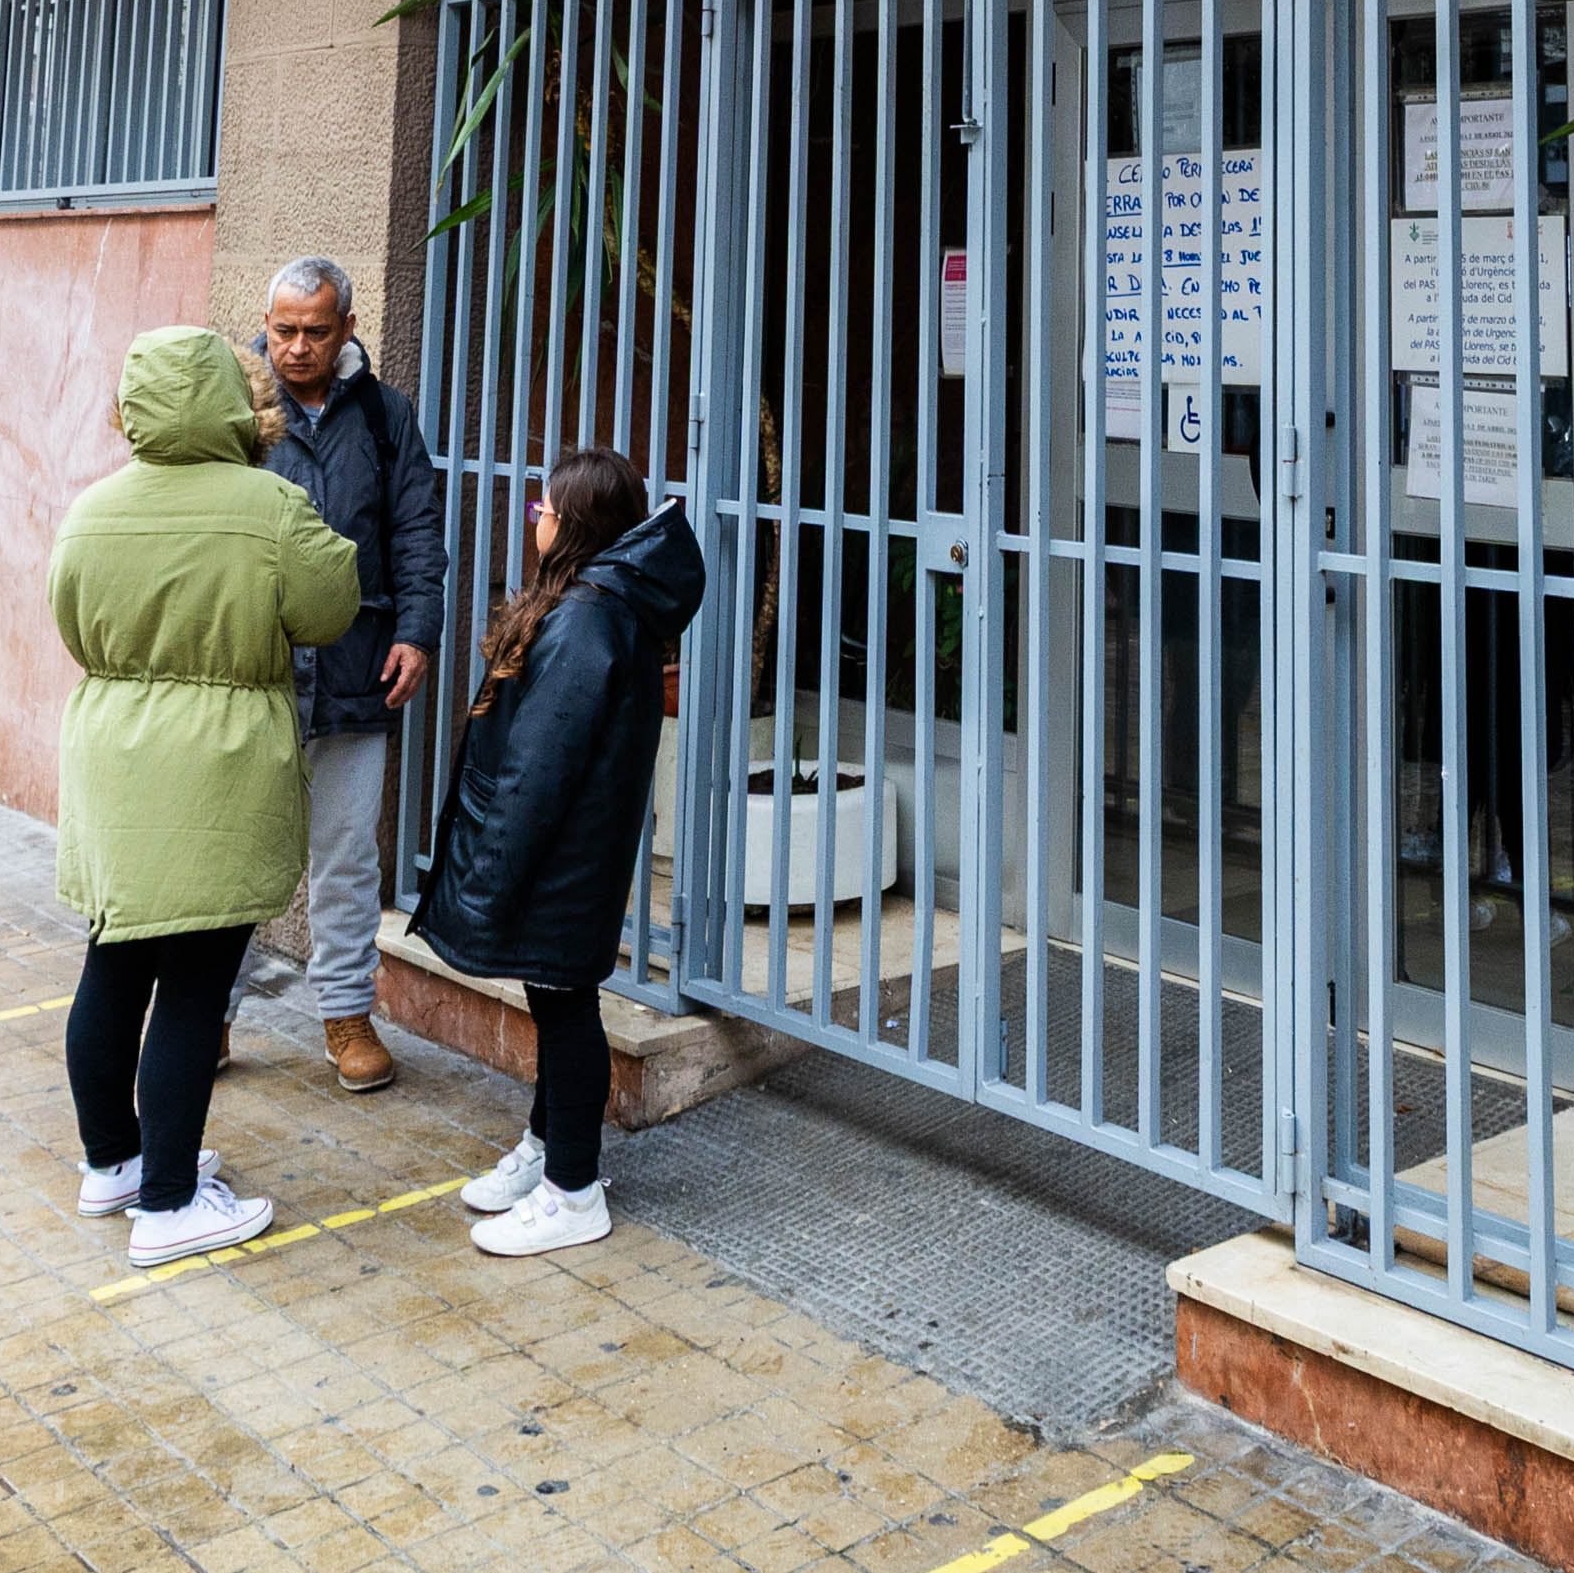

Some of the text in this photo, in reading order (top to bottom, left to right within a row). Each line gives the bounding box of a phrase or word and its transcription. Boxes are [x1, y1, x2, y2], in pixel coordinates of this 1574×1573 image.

[1238, 188, 1260, 203] DE
[1405, 255, 1411, 263] A
[1469, 254, 1480, 263] de
[1483, 256, 1505, 266] març
[1403, 281, 1417, 290] del
[1419, 281, 1436, 290] PAS
[1498, 283, 1509, 291] es
[1481, 294, 1494, 303] del
[1497, 294, 1512, 303] Cid
[1408, 314, 1415, 322] A
[1467, 314, 1478, 324] de
[1480, 316, 1507, 324] marzo
[1473, 328, 1483, 337] de
[1410, 340, 1423, 349] del
[1498, 343, 1509, 351] se
[1482, 355, 1495, 365] del
[1497, 355, 1511, 365] Cid
